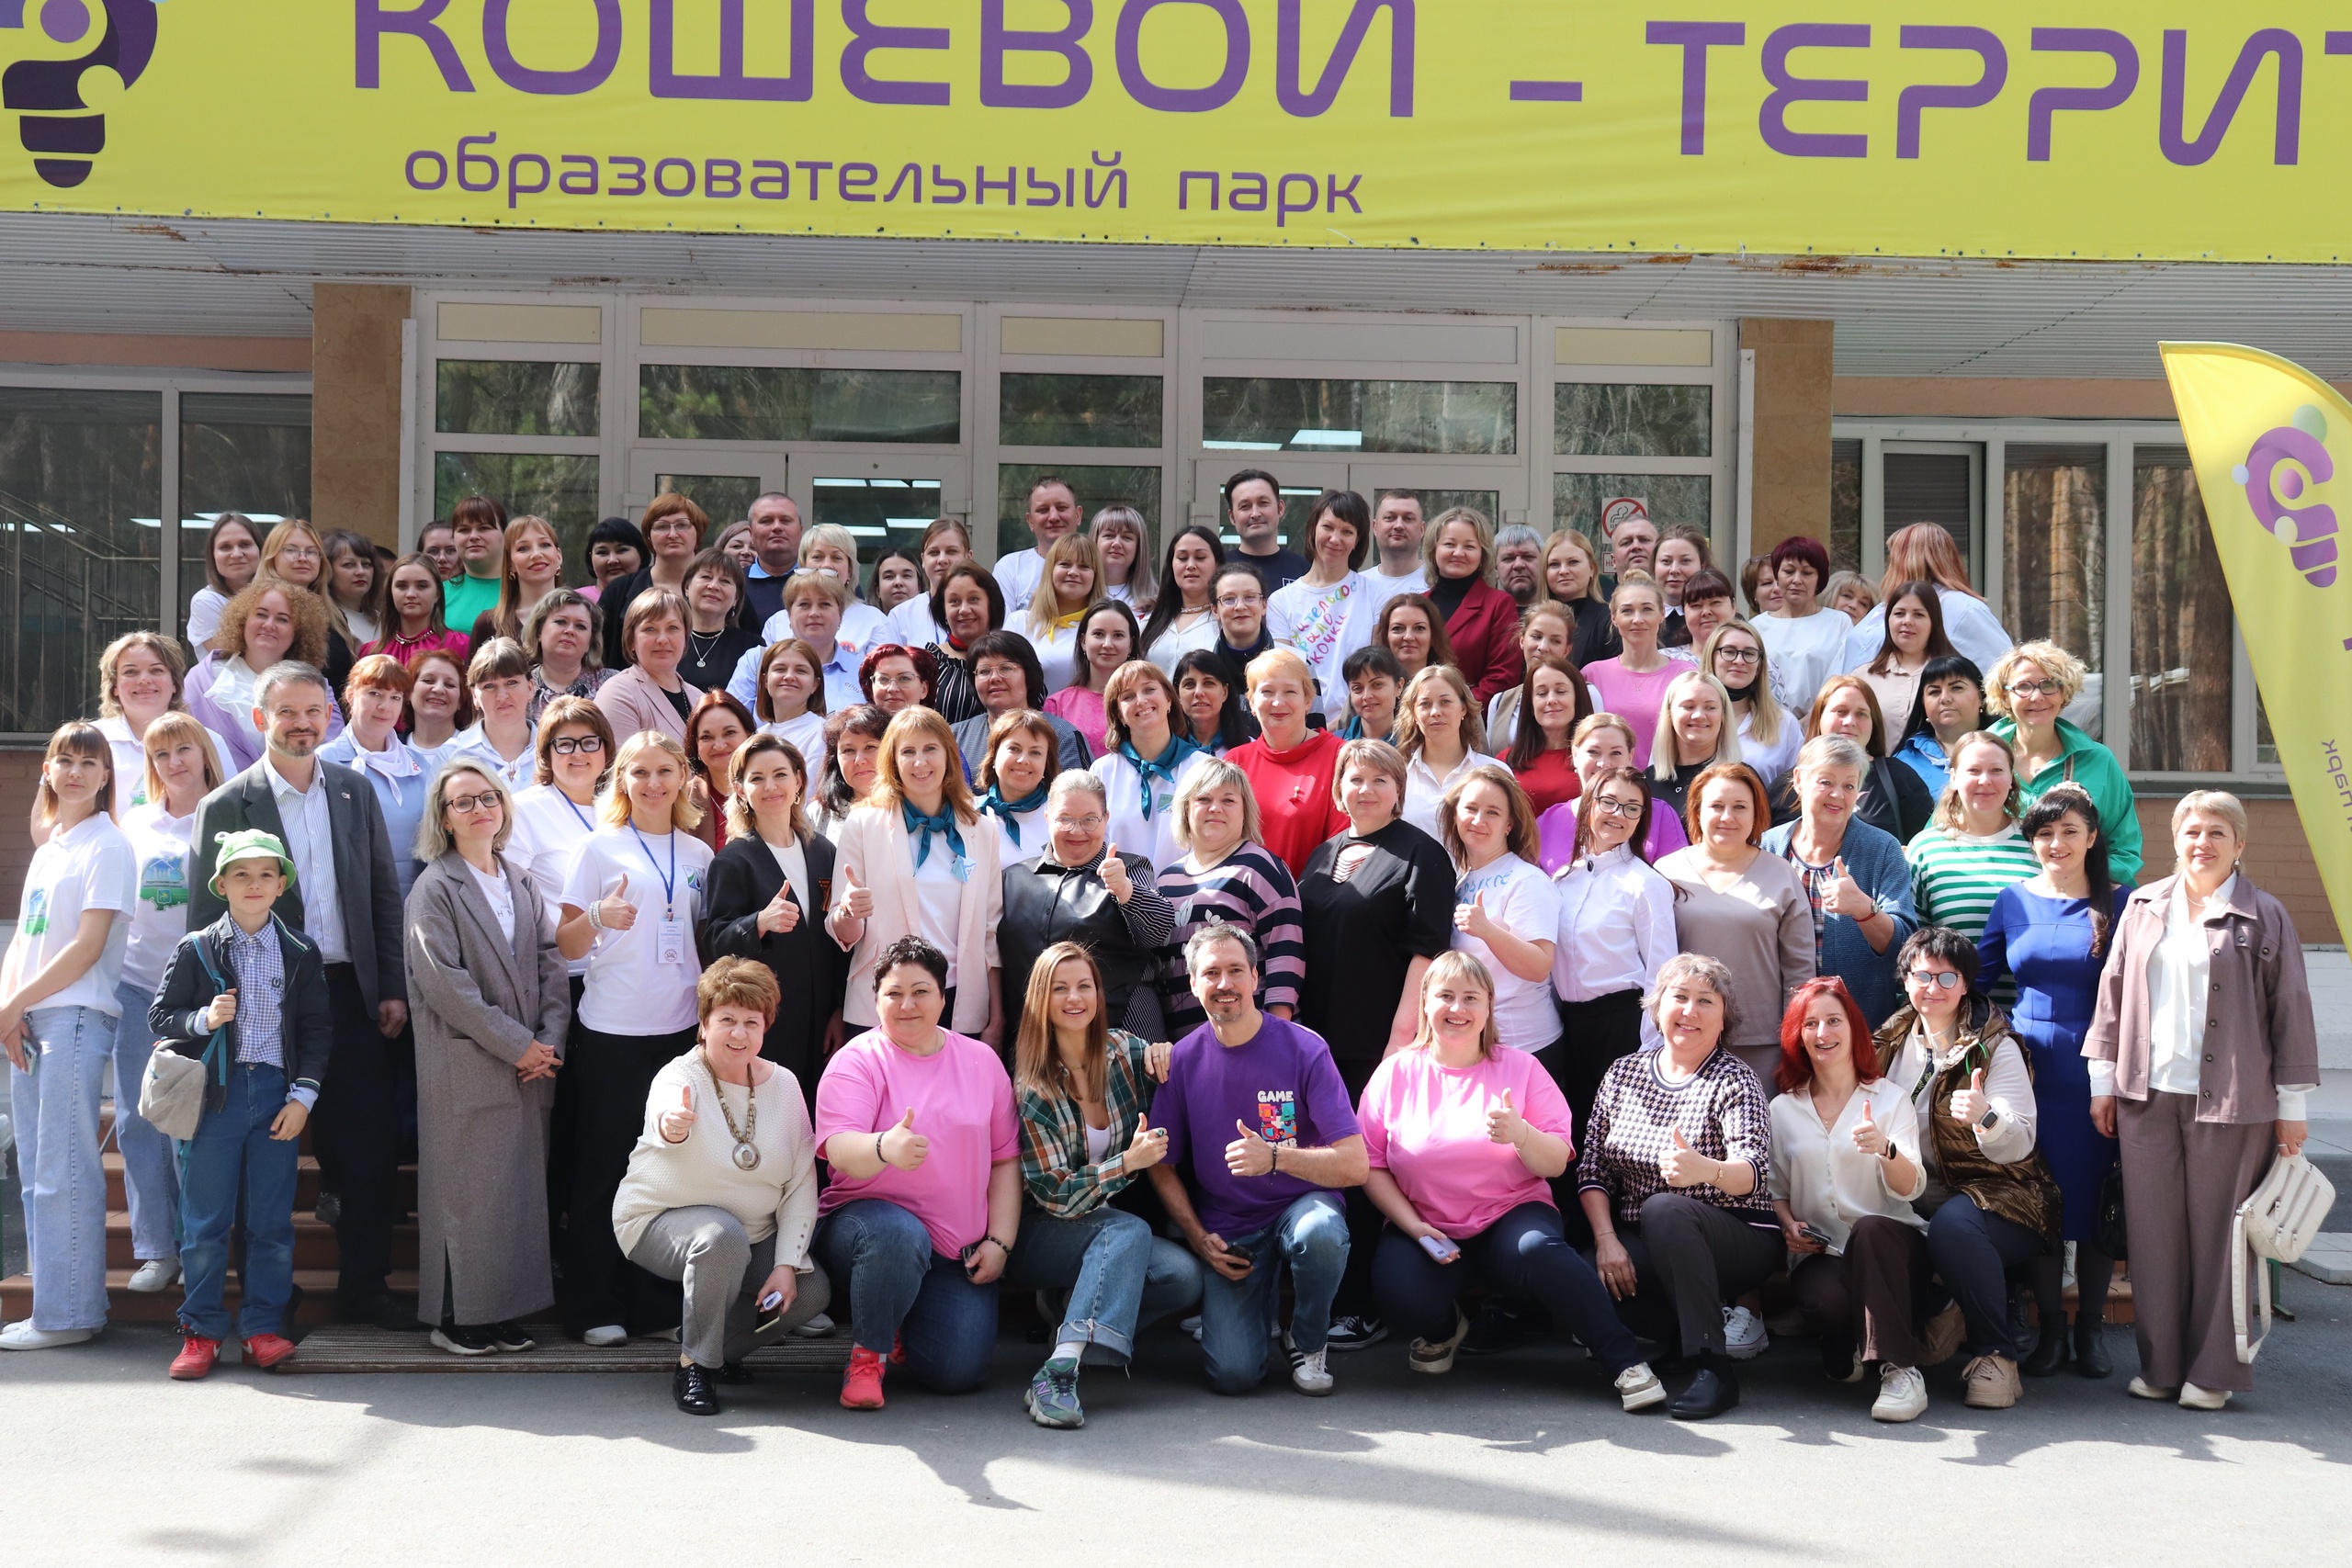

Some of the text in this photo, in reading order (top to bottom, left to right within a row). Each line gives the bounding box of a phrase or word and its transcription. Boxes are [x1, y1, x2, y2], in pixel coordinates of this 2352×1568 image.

[1645, 21, 2352, 166] ТЕРРИ
[405, 131, 1362, 227] образовательный парк
[1257, 1090, 1295, 1102] GAME
